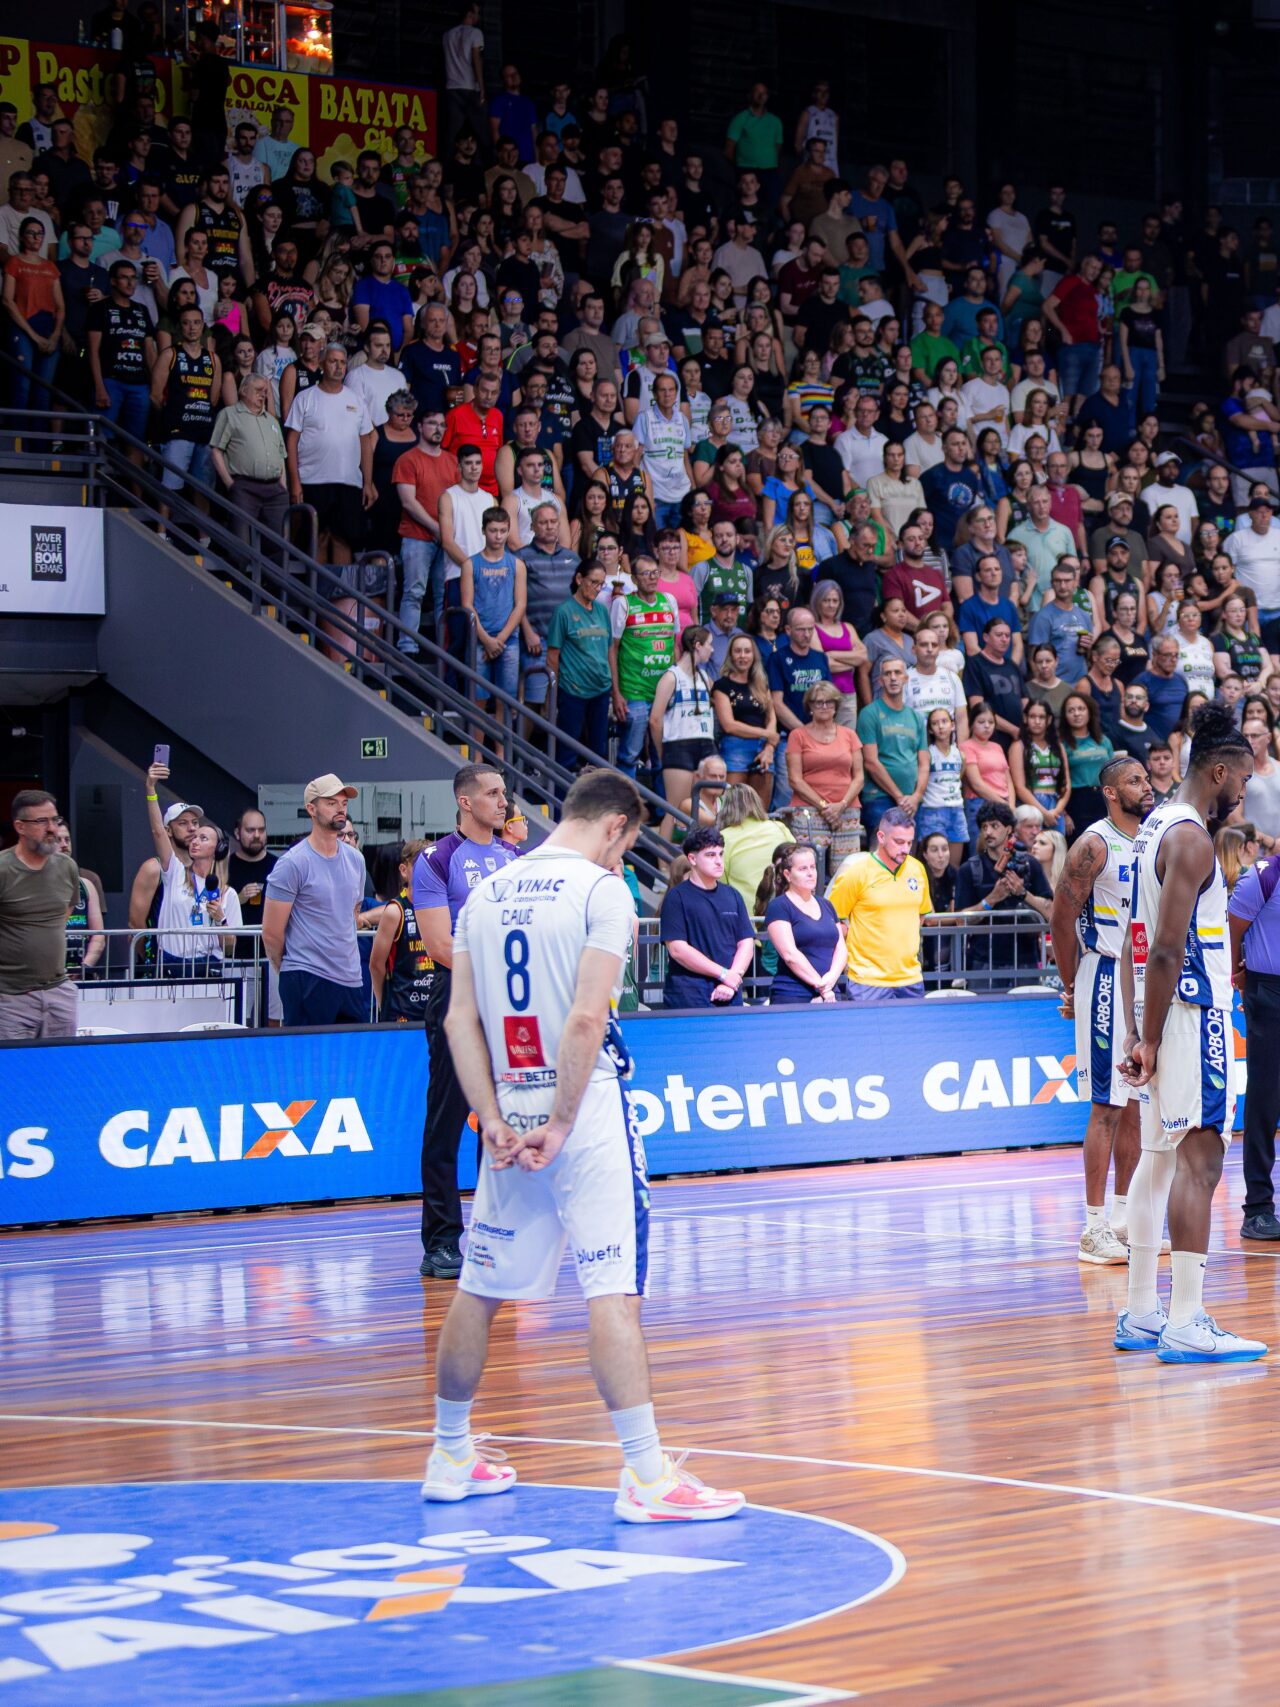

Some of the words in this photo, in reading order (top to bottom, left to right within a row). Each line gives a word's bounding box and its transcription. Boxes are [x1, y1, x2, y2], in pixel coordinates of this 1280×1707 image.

[319, 83, 428, 132] BATATA
[35, 533, 62, 543] VIVER
[35, 552, 62, 564] BOM
[643, 655, 670, 665] KTO
[517, 878, 565, 893] VINAC
[504, 929, 530, 1012] 8
[1095, 973, 1113, 1036] ÁRBORE
[1204, 1007, 1225, 1074] ÁRBOR
[632, 1058, 890, 1137] oterias
[922, 1055, 1080, 1112] CAIX
[99, 1097, 374, 1169] CAIXA
[576, 1244, 622, 1265] bluefit
[0, 1529, 551, 1616] erias
[0, 1547, 748, 1682] AIXA
